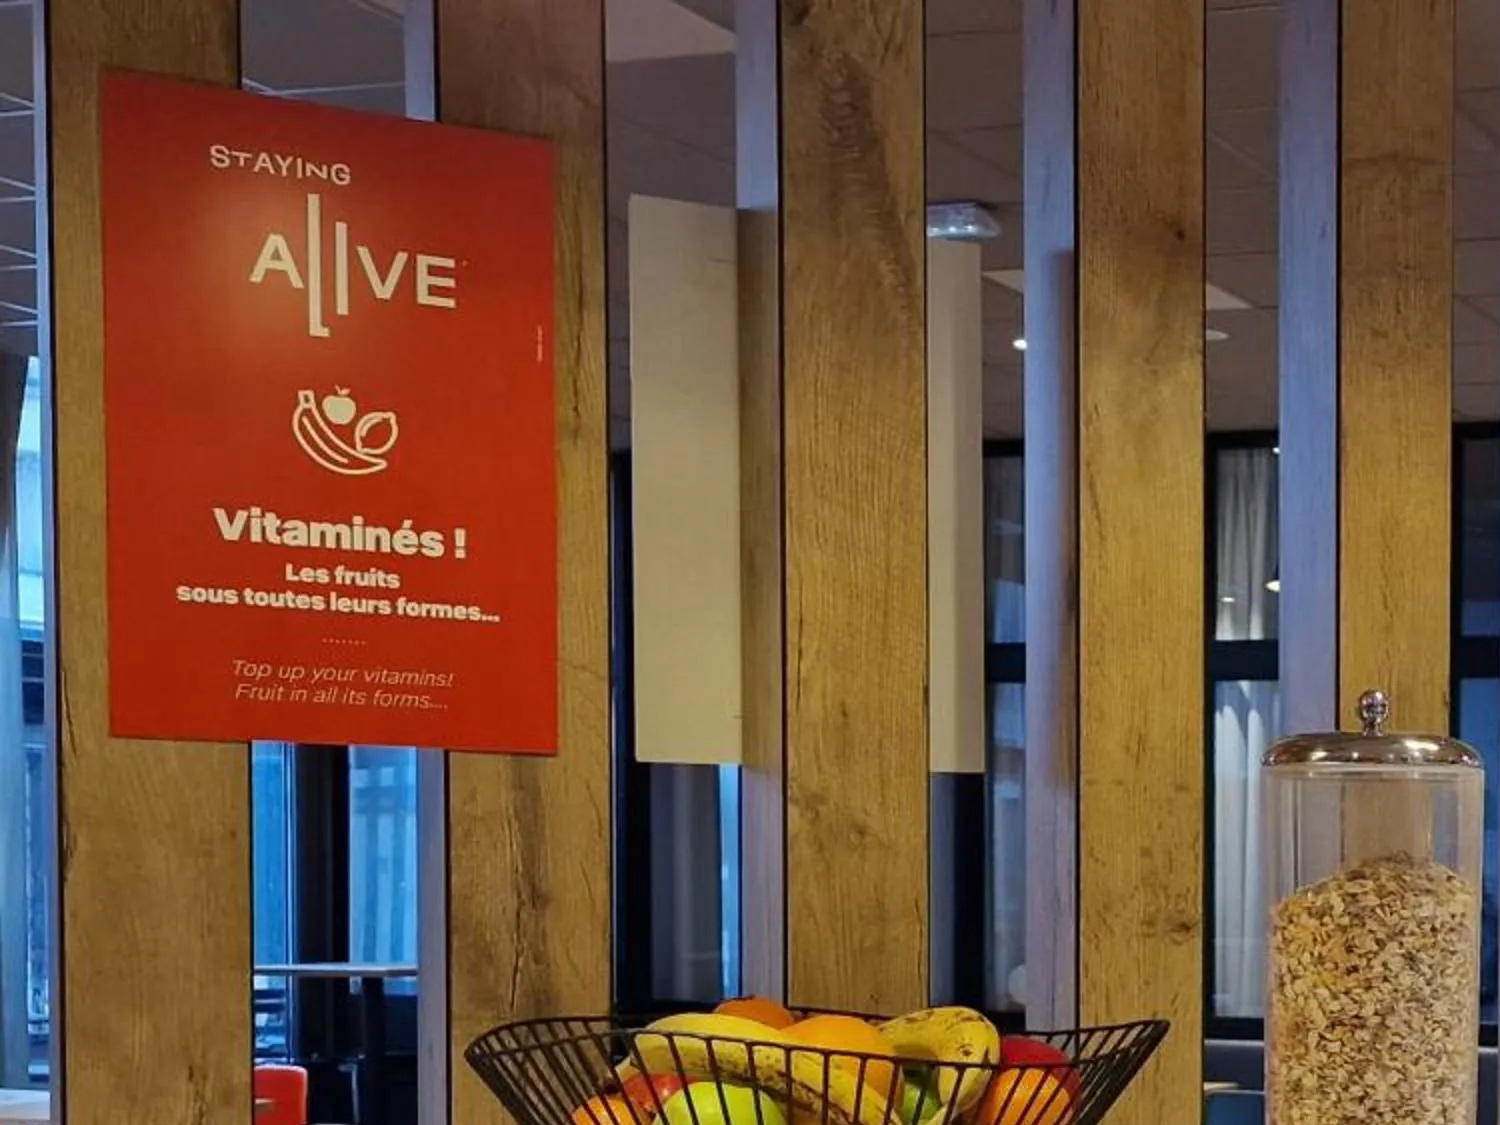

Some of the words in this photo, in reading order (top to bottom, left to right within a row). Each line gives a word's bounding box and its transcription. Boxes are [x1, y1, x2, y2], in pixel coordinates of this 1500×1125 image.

[210, 145, 351, 185] STAYING
[250, 193, 456, 338] ALIVE
[213, 506, 445, 557] Vitaminés
[285, 563, 330, 584] Les
[335, 564, 400, 589] fruits
[176, 585, 239, 605] sous
[243, 587, 326, 611] toutes
[330, 591, 392, 615] leurs
[396, 597, 501, 623] formes...
[231, 659, 271, 681] Top
[278, 666, 305, 683] up
[312, 667, 357, 684] your
[363, 667, 454, 688] vitamins!
[235, 683, 284, 701] Fruit
[289, 684, 308, 702] in
[313, 686, 338, 704] all
[342, 687, 368, 706] its
